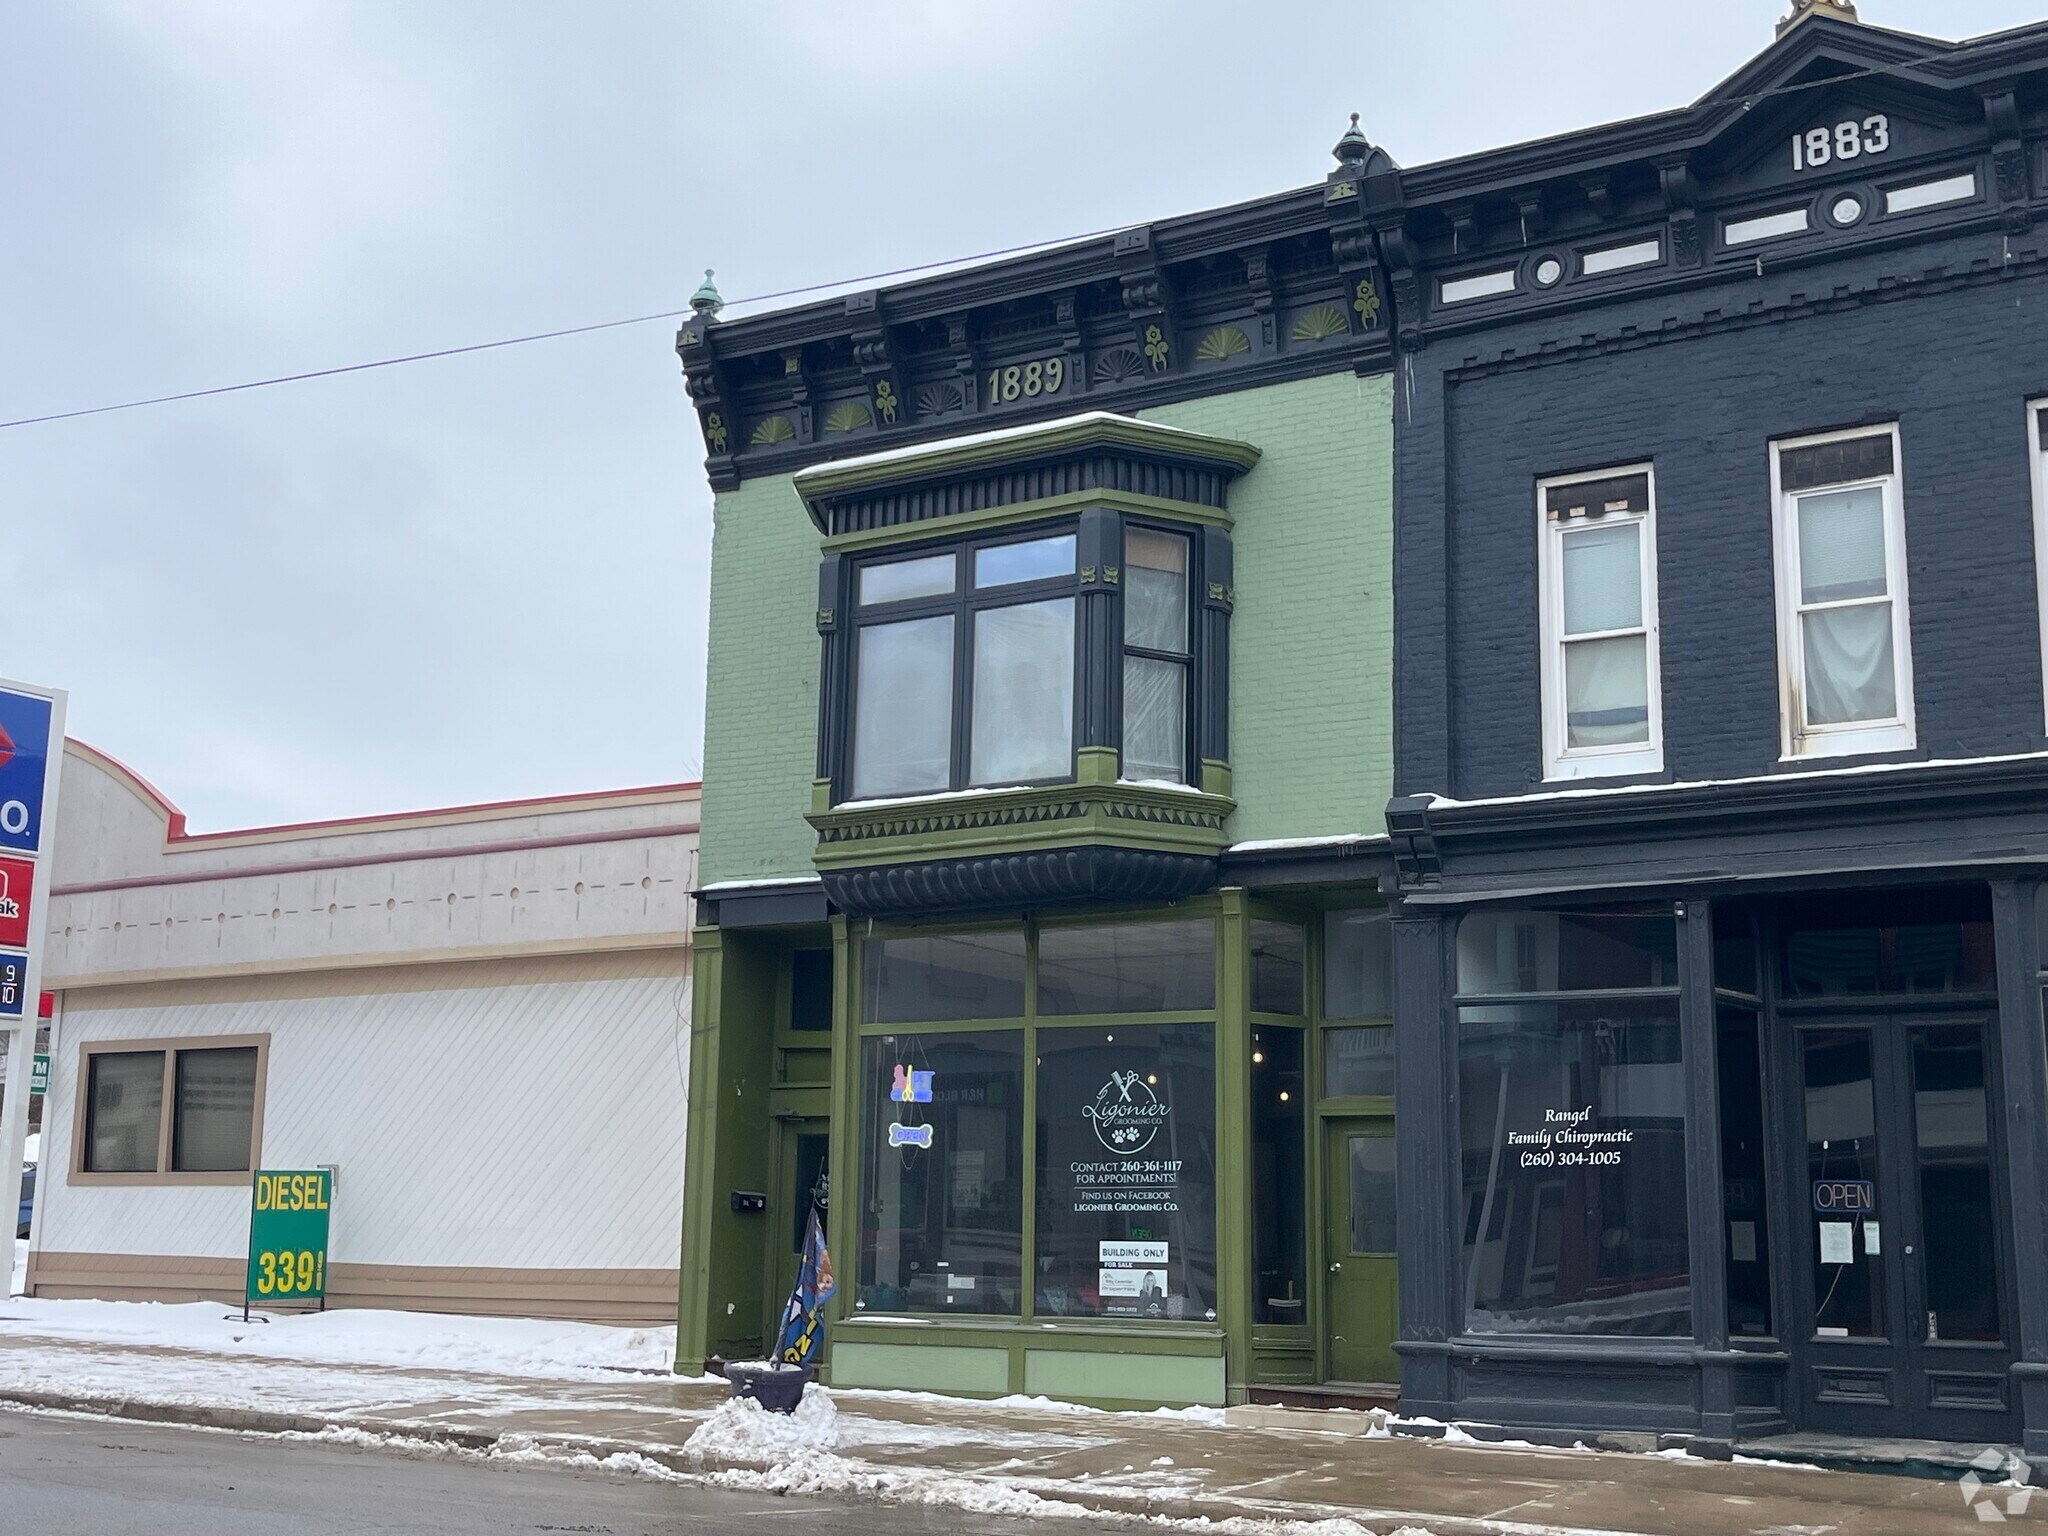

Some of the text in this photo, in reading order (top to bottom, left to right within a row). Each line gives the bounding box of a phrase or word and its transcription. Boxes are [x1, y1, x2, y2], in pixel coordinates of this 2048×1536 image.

[1792, 114, 1890, 171] 1883
[989, 358, 1063, 405] 1889
[1082, 1089, 1172, 1127] Ligonier
[1545, 1105, 1592, 1127] Rangel
[896, 1130, 926, 1142] OPEN
[1508, 1128, 1633, 1149] Family Chiropractic
[1120, 1160, 1182, 1171] 260-361-1117
[1520, 1150, 1621, 1168] (260) 304-1005
[1076, 1173, 1177, 1183] FOR APPOINTMENTS!
[256, 1175, 328, 1211] DIESEL
[1081, 1191, 1171, 1200] FIND US ON FACEBOOK
[1816, 1184, 1871, 1209] OPEN
[1074, 1203, 1114, 1212] LIGONIER
[1114, 1202, 1162, 1211] GROOMING
[1102, 1248, 1165, 1257] BUILDING ONLY
[258, 1250, 315, 1294] 339
